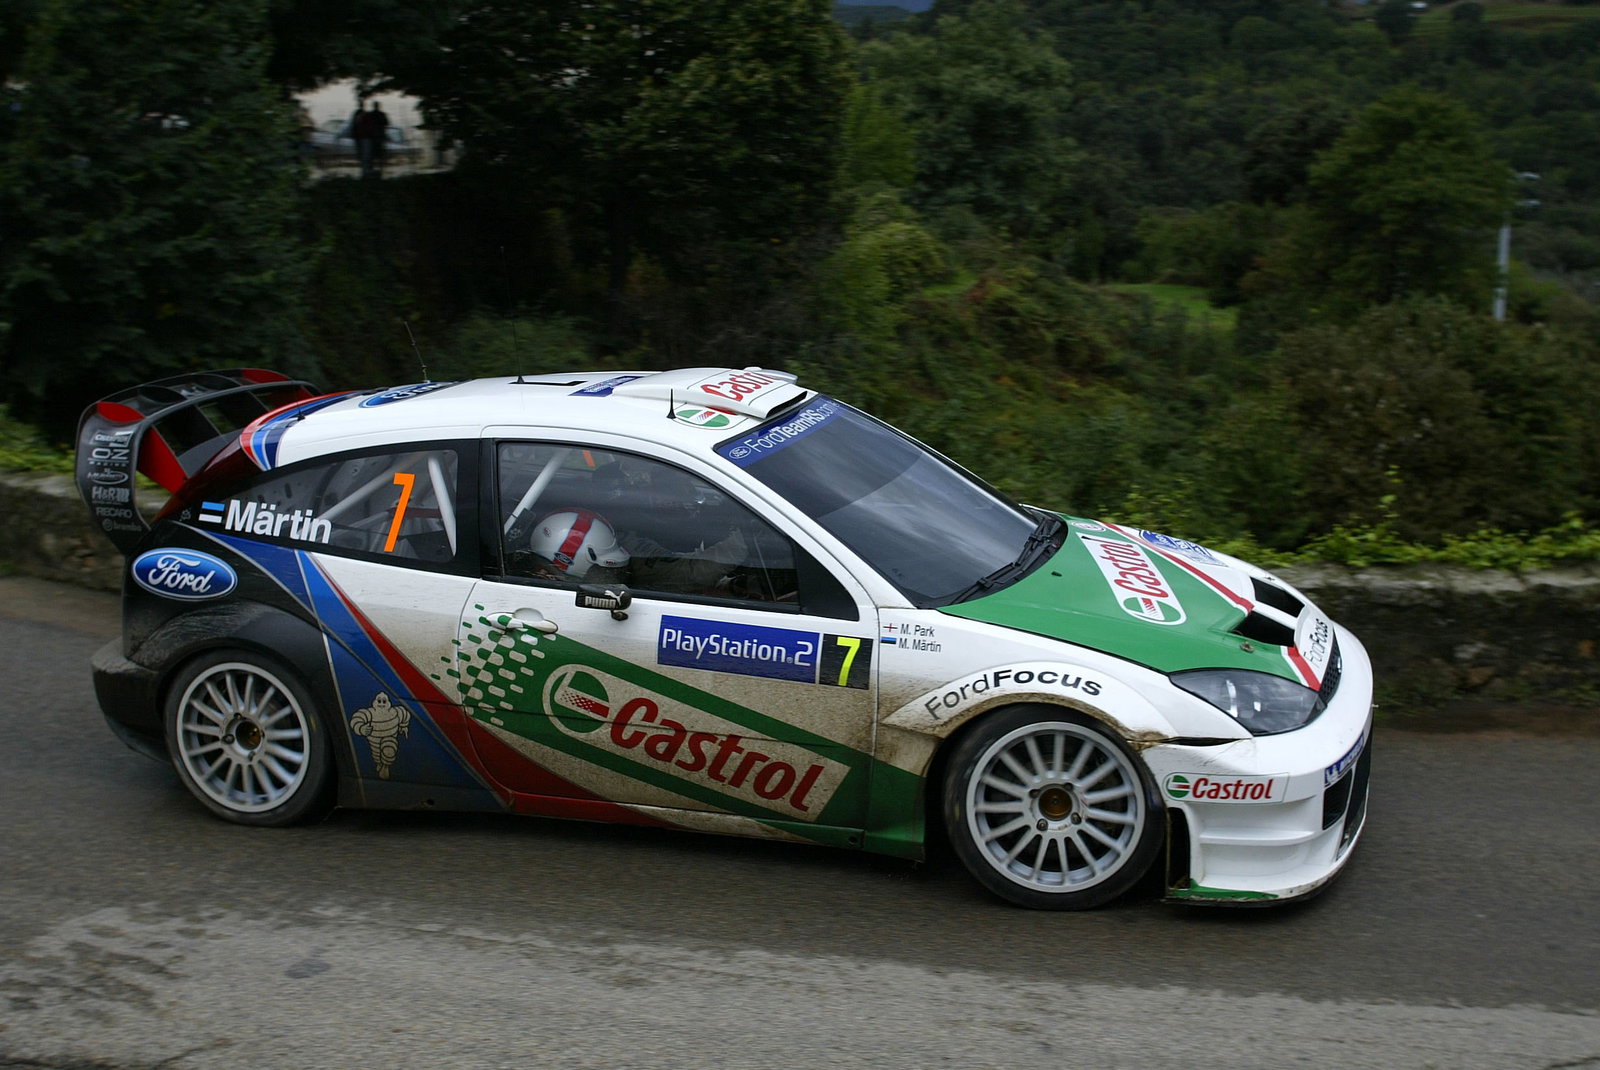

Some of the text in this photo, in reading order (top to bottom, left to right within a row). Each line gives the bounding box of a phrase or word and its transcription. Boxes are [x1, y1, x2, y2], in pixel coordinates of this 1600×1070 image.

[701, 372, 777, 402] Castr
[225, 498, 332, 544] Märtin
[384, 471, 416, 553] 7
[148, 555, 216, 593] Ford
[1080, 535, 1169, 598] Castrol
[899, 638, 941, 653] M. Märtin
[900, 624, 935, 638] M. Park
[836, 636, 862, 687] 7
[924, 669, 1103, 720] FordFocus
[610, 697, 825, 812] Castrol
[1192, 777, 1274, 801] Castrol
